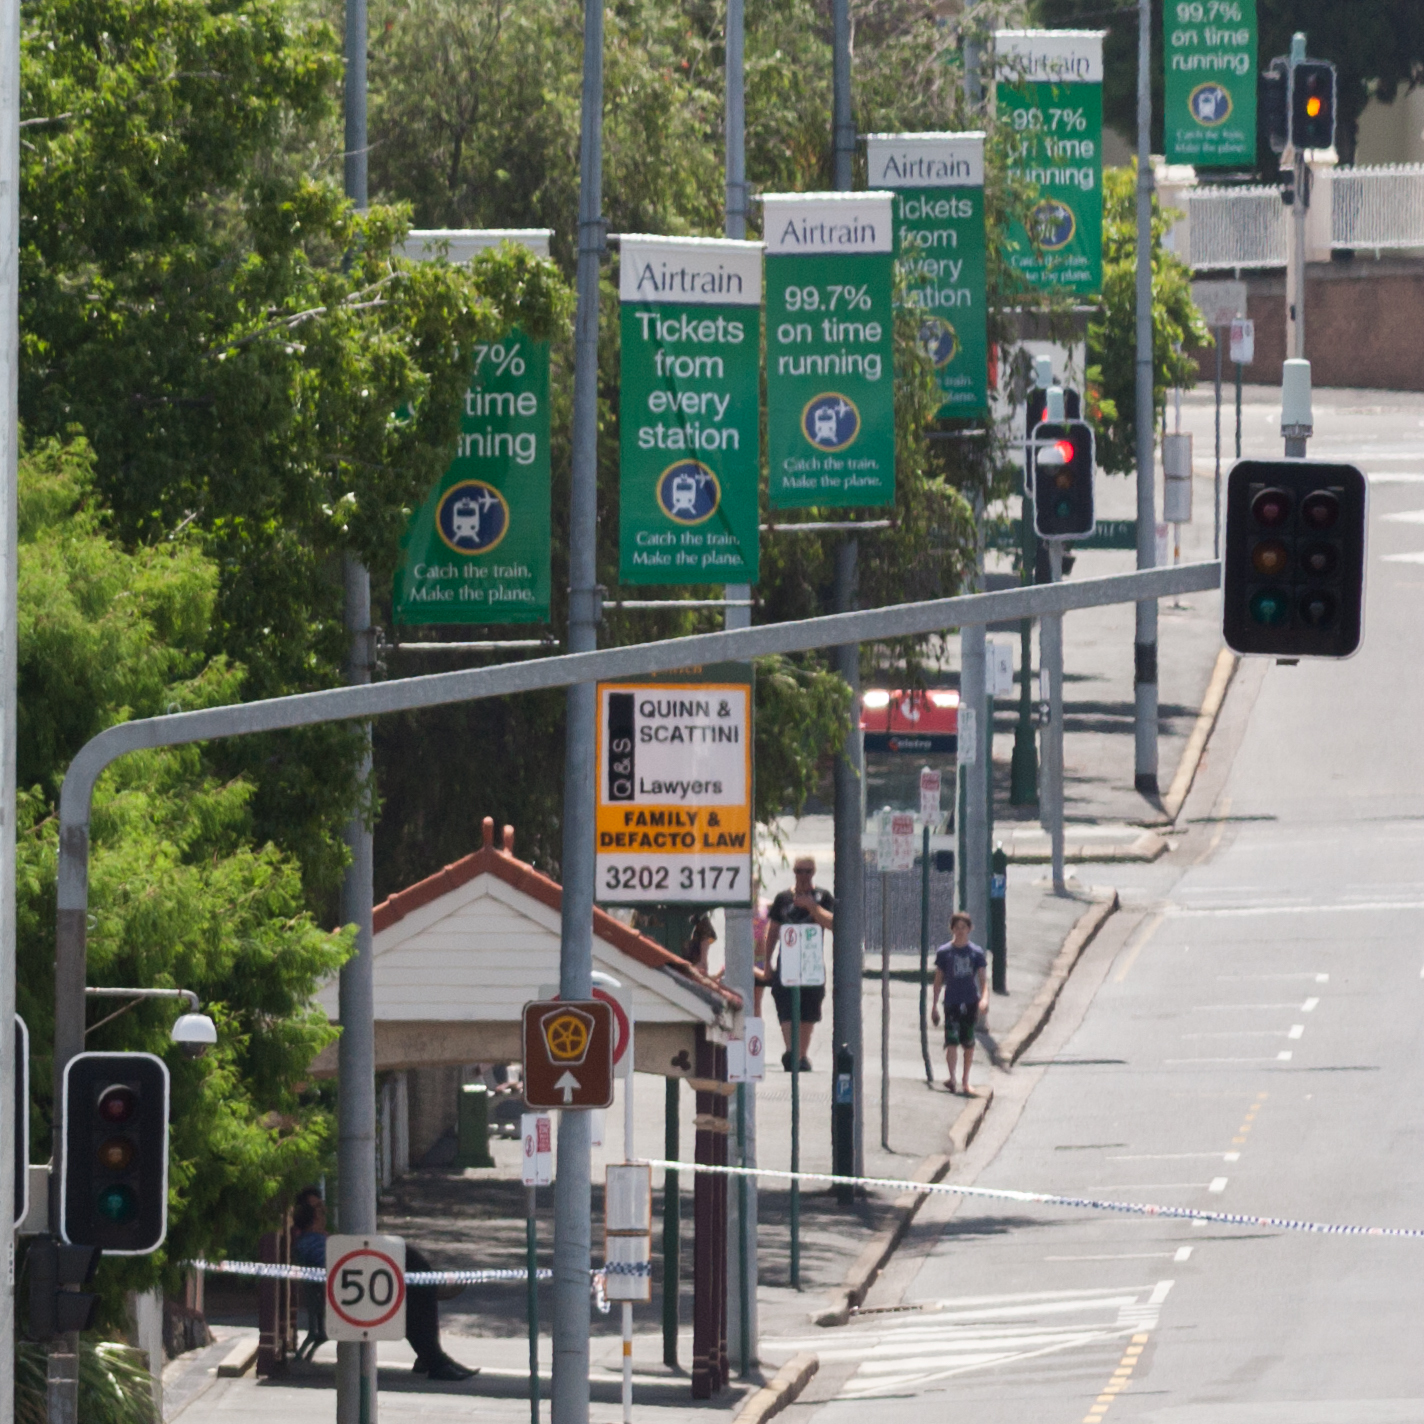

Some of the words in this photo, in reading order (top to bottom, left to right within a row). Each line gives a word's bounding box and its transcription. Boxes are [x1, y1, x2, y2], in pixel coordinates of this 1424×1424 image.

[1177, 1, 1242, 23] 99.7%
[1171, 28, 1198, 47] on
[1204, 25, 1249, 47] time
[1172, 51, 1250, 75] running
[883, 153, 971, 180] Airtrain
[899, 195, 973, 220] ickets
[779, 216, 876, 245] Airtrain
[636, 262, 743, 294] Airtrain
[784, 284, 872, 312] 99.7%
[635, 311, 745, 344] Tickets
[777, 322, 812, 344] on
[822, 317, 882, 343] time
[654, 351, 724, 379] from
[778, 349, 882, 381] running
[465, 386, 538, 417] time
[648, 390, 730, 422] every
[638, 424, 740, 450] station
[783, 456, 820, 472] Catch
[824, 456, 845, 471] the
[782, 475, 818, 489] Make
[821, 475, 841, 489] the
[843, 475, 882, 491] plane.
[636, 530, 677, 546] Catch
[680, 530, 703, 545] the
[706, 531, 740, 546] train.
[414, 562, 459, 580] Catch
[463, 561, 488, 579] the
[492, 563, 533, 579] train.
[633, 550, 672, 566] Make
[676, 550, 699, 565] the
[702, 551, 744, 568] plane.
[410, 585, 455, 602] Make
[459, 585, 485, 602] the
[488, 585, 536, 606] plane.
[639, 700, 711, 719] QUINN
[717, 700, 731, 718] &
[639, 725, 740, 743] SCATTINI
[640, 777, 723, 799] Lawyers
[624, 811, 698, 827] FAMILY
[707, 811, 721, 827] &
[600, 832, 695, 848] DEFACTO
[703, 832, 746, 848] LAW
[605, 865, 670, 890] 3202
[680, 866, 741, 890] 3177
[340, 1268, 394, 1307] 50
